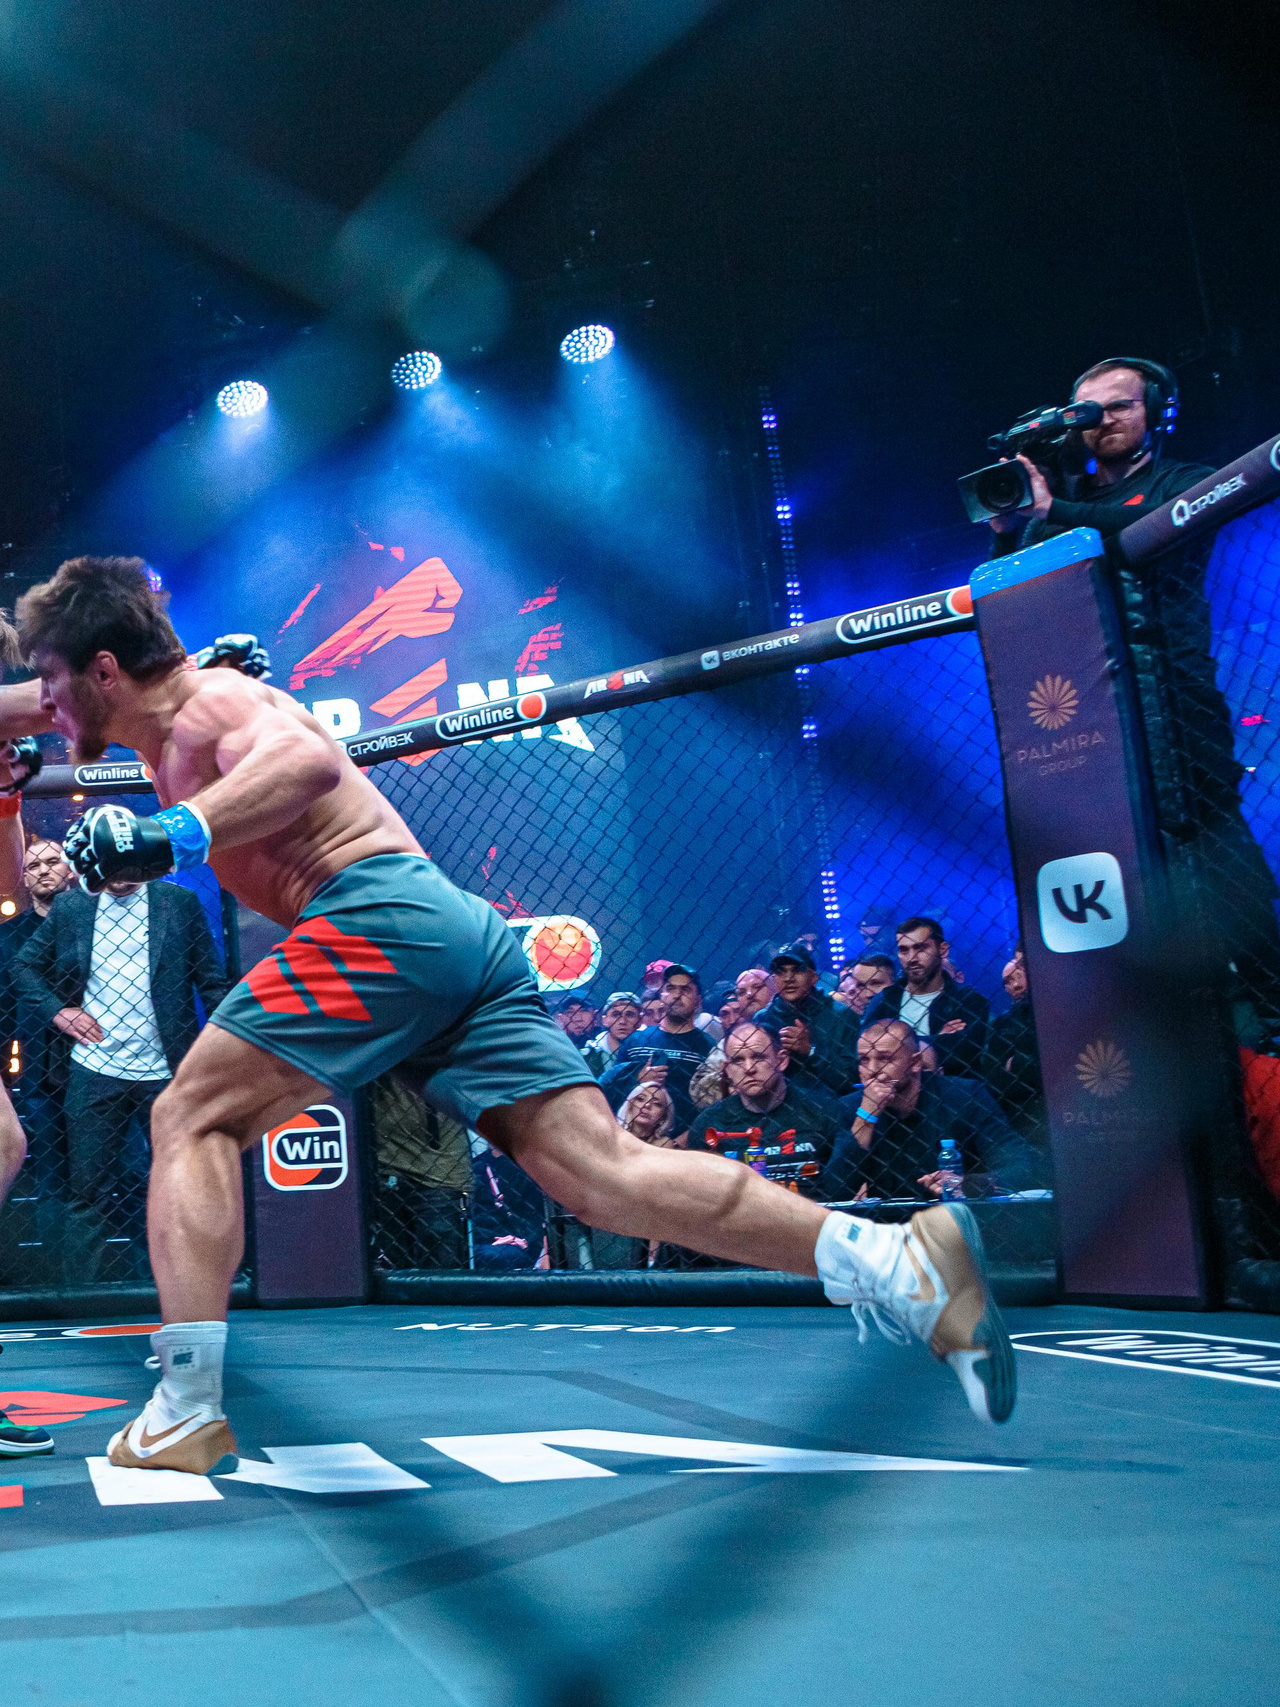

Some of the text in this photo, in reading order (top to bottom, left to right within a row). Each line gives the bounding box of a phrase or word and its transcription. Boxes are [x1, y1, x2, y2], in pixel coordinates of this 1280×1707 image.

[848, 600, 942, 634] Winline
[584, 670, 651, 699] ARENA
[445, 704, 515, 733] Winline
[1017, 731, 1106, 764] PALMIRA
[82, 768, 139, 780] Winline
[281, 1136, 340, 1160] Win
